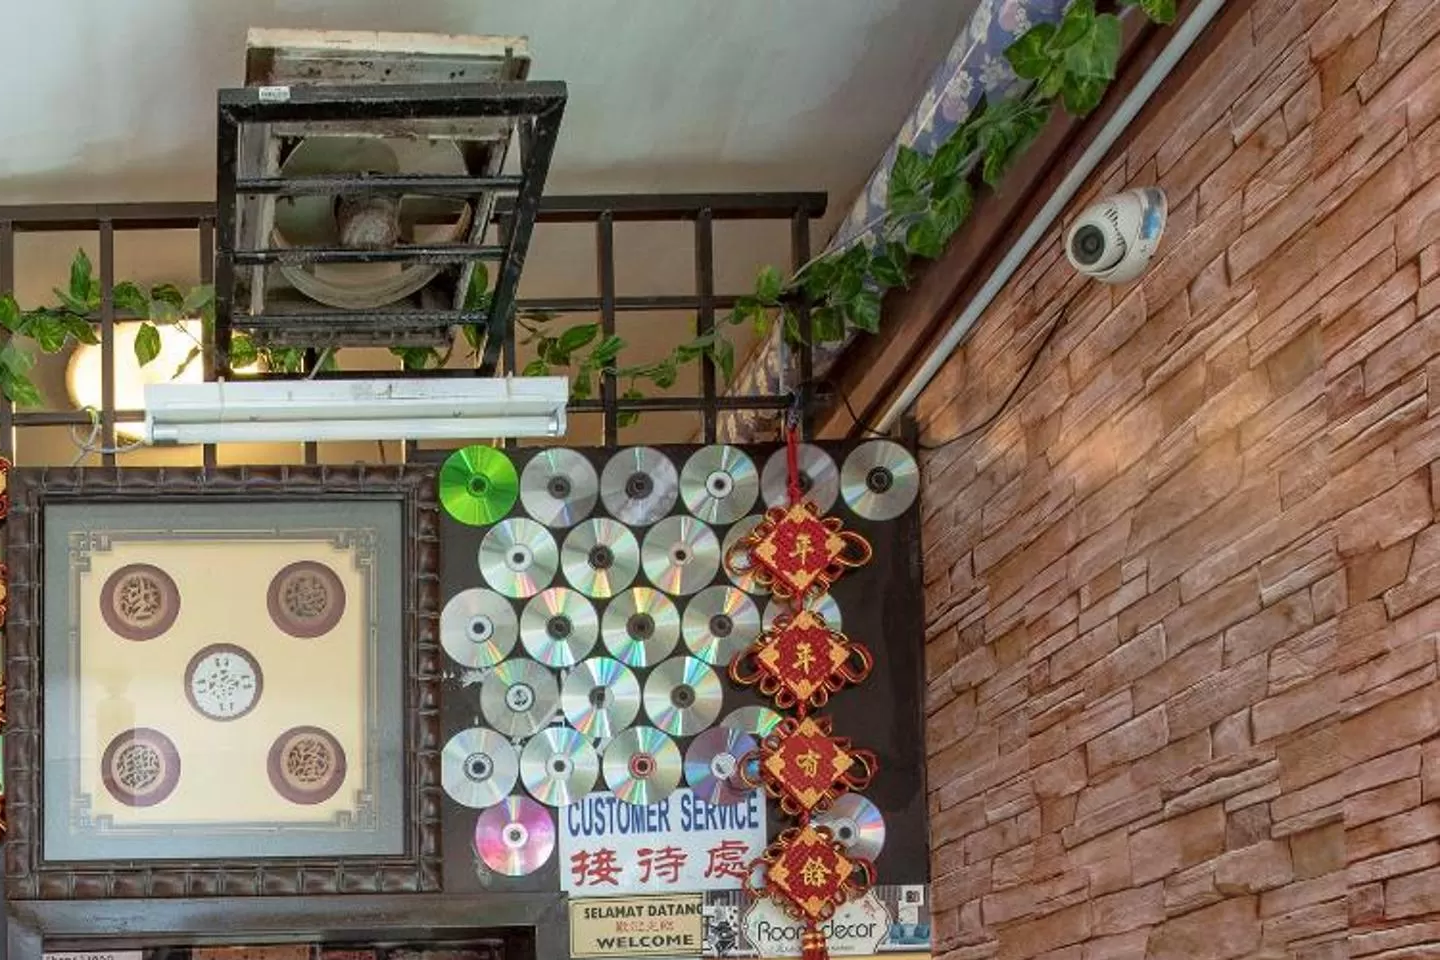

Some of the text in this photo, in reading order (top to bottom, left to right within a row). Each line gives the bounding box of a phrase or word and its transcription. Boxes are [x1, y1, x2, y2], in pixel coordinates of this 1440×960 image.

[568, 792, 759, 836] CUSTOMER SERVICE
[570, 840, 750, 887] 接待處
[584, 903, 703, 919] SELAMAT DATANG
[821, 919, 877, 939] decor
[597, 934, 695, 949] WELCOME
